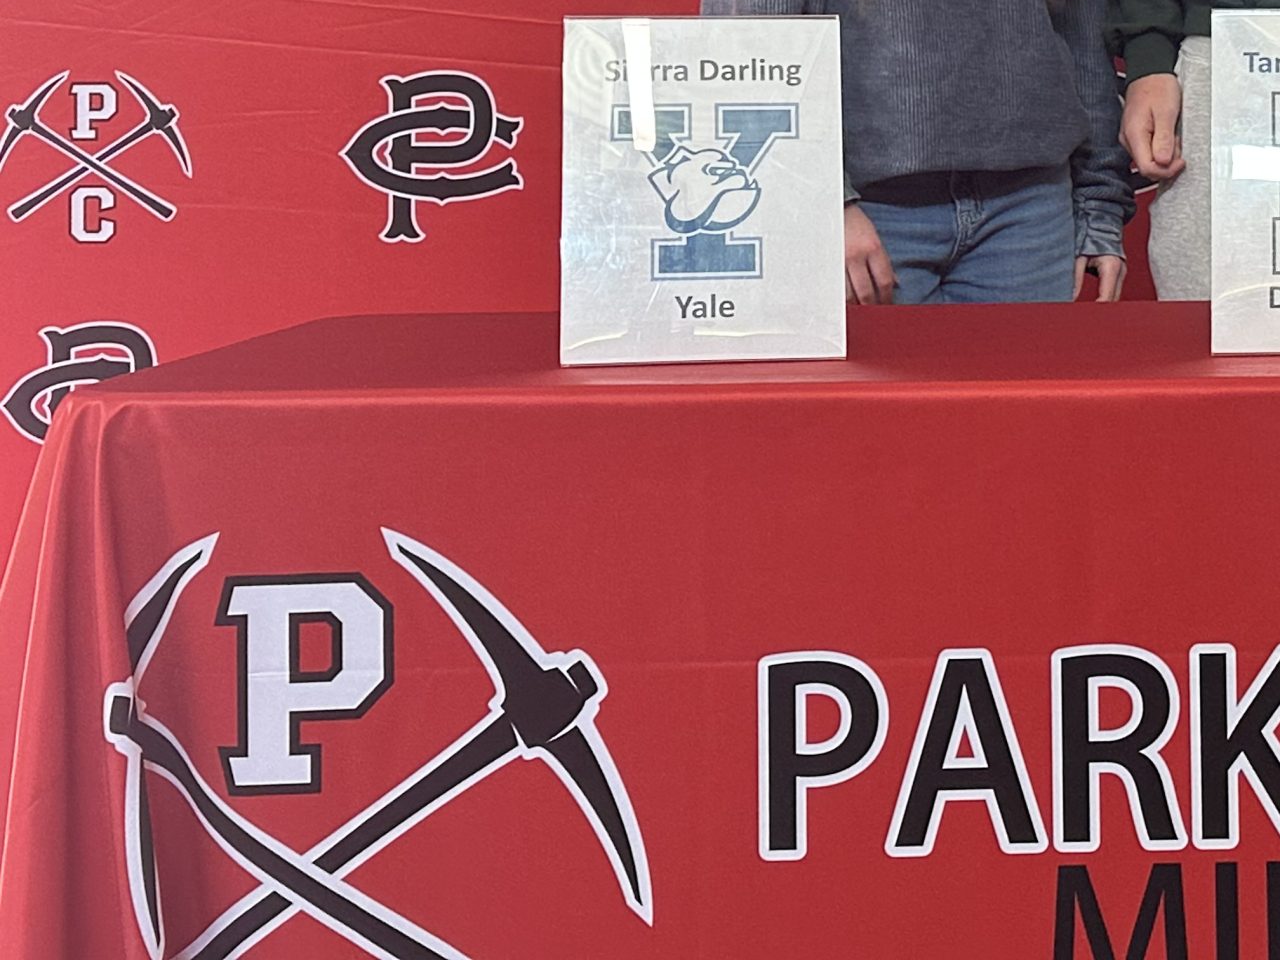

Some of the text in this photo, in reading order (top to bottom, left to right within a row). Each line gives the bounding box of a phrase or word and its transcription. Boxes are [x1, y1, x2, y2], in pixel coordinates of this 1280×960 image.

[604, 58, 802, 86] Sirra Darling
[69, 82, 118, 140] P
[70, 185, 115, 243] C
[675, 294, 735, 319] Yale
[214, 572, 394, 796] P
